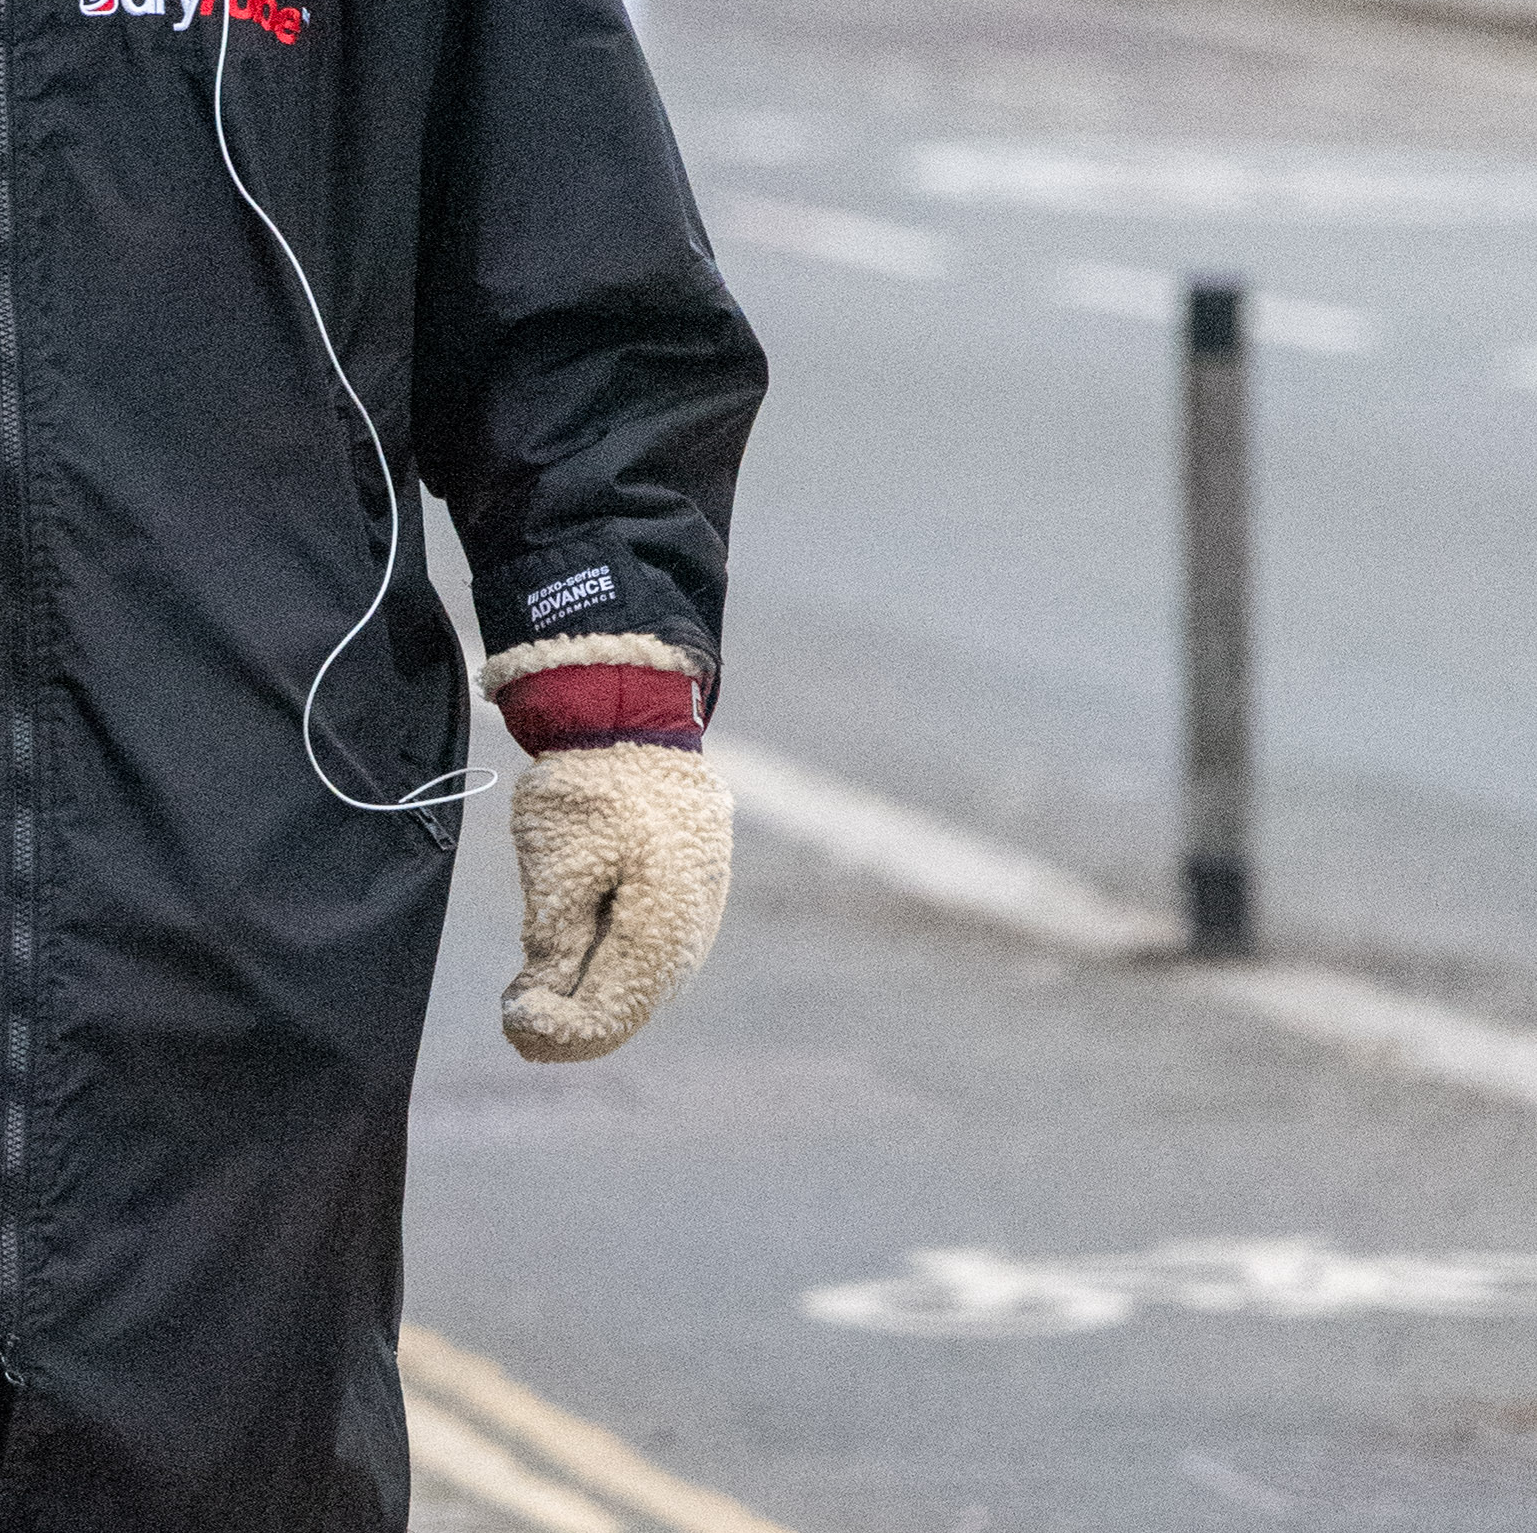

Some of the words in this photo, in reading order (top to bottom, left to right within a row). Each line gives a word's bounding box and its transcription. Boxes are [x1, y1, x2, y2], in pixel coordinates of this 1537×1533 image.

[531, 575, 614, 622] ADVANCE
[540, 565, 610, 598] exo-series
[535, 591, 616, 631] PERFORMANCE
